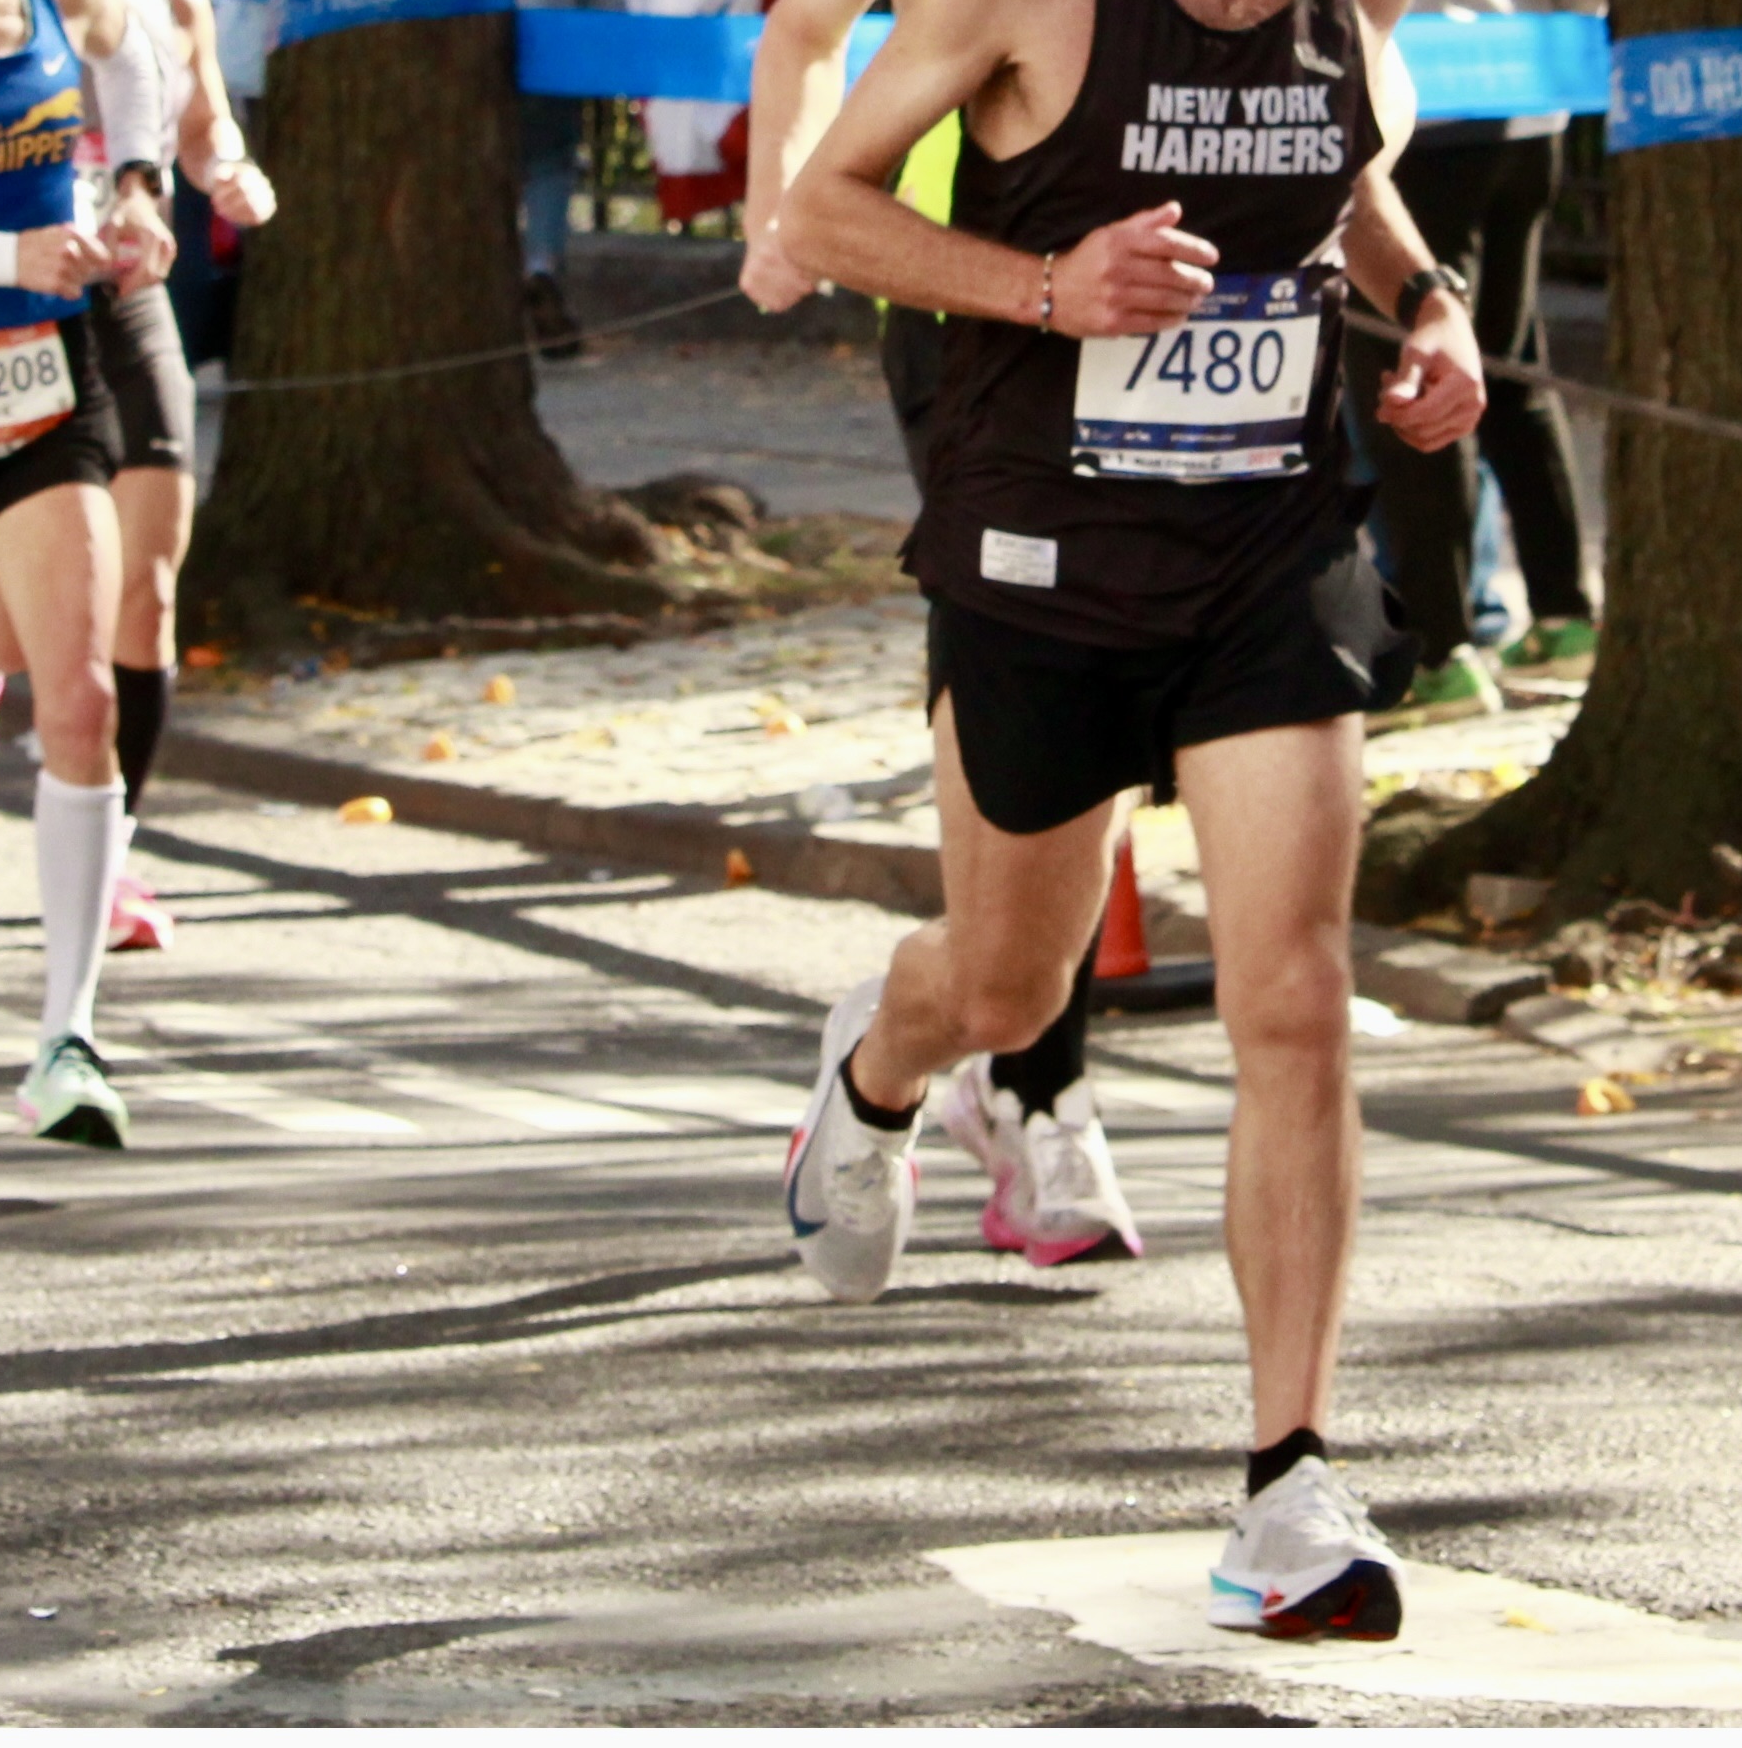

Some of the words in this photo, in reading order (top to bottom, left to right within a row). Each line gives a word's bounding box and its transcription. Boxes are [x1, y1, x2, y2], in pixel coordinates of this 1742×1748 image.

[1147, 84, 1232, 125] NEW
[1238, 84, 1330, 125] YORK
[1121, 123, 1345, 176] HARRIERS
[1124, 329, 1285, 394] 7480
